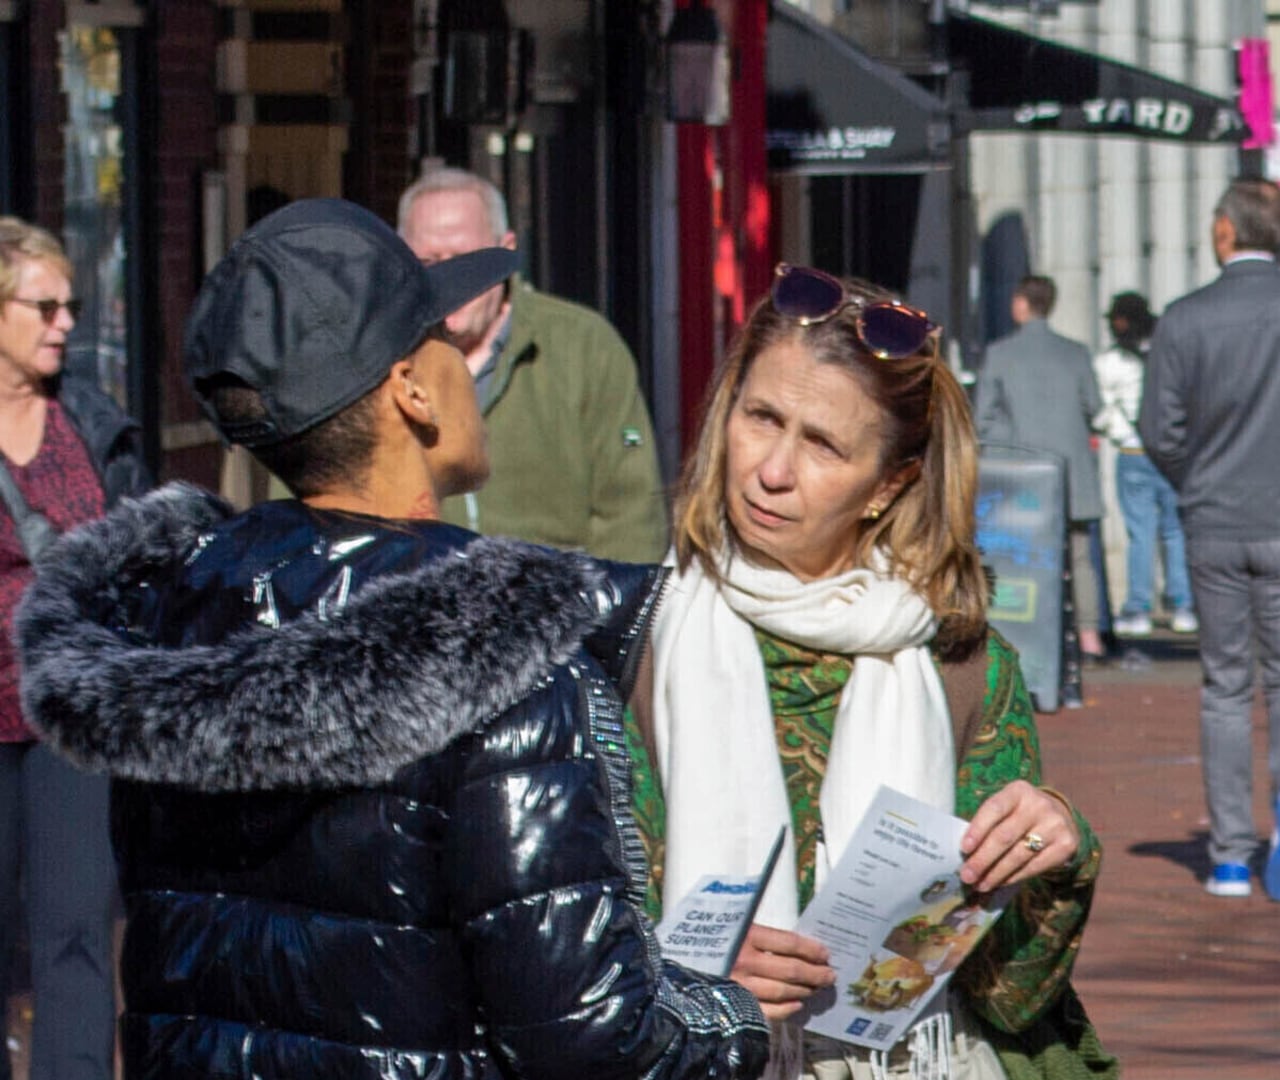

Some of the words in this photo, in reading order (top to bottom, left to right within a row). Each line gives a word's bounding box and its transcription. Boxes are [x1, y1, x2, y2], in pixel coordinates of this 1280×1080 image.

[1083, 99, 1192, 135] YARD
[686, 910, 713, 922] CAN
[675, 923, 728, 935] PLANET
